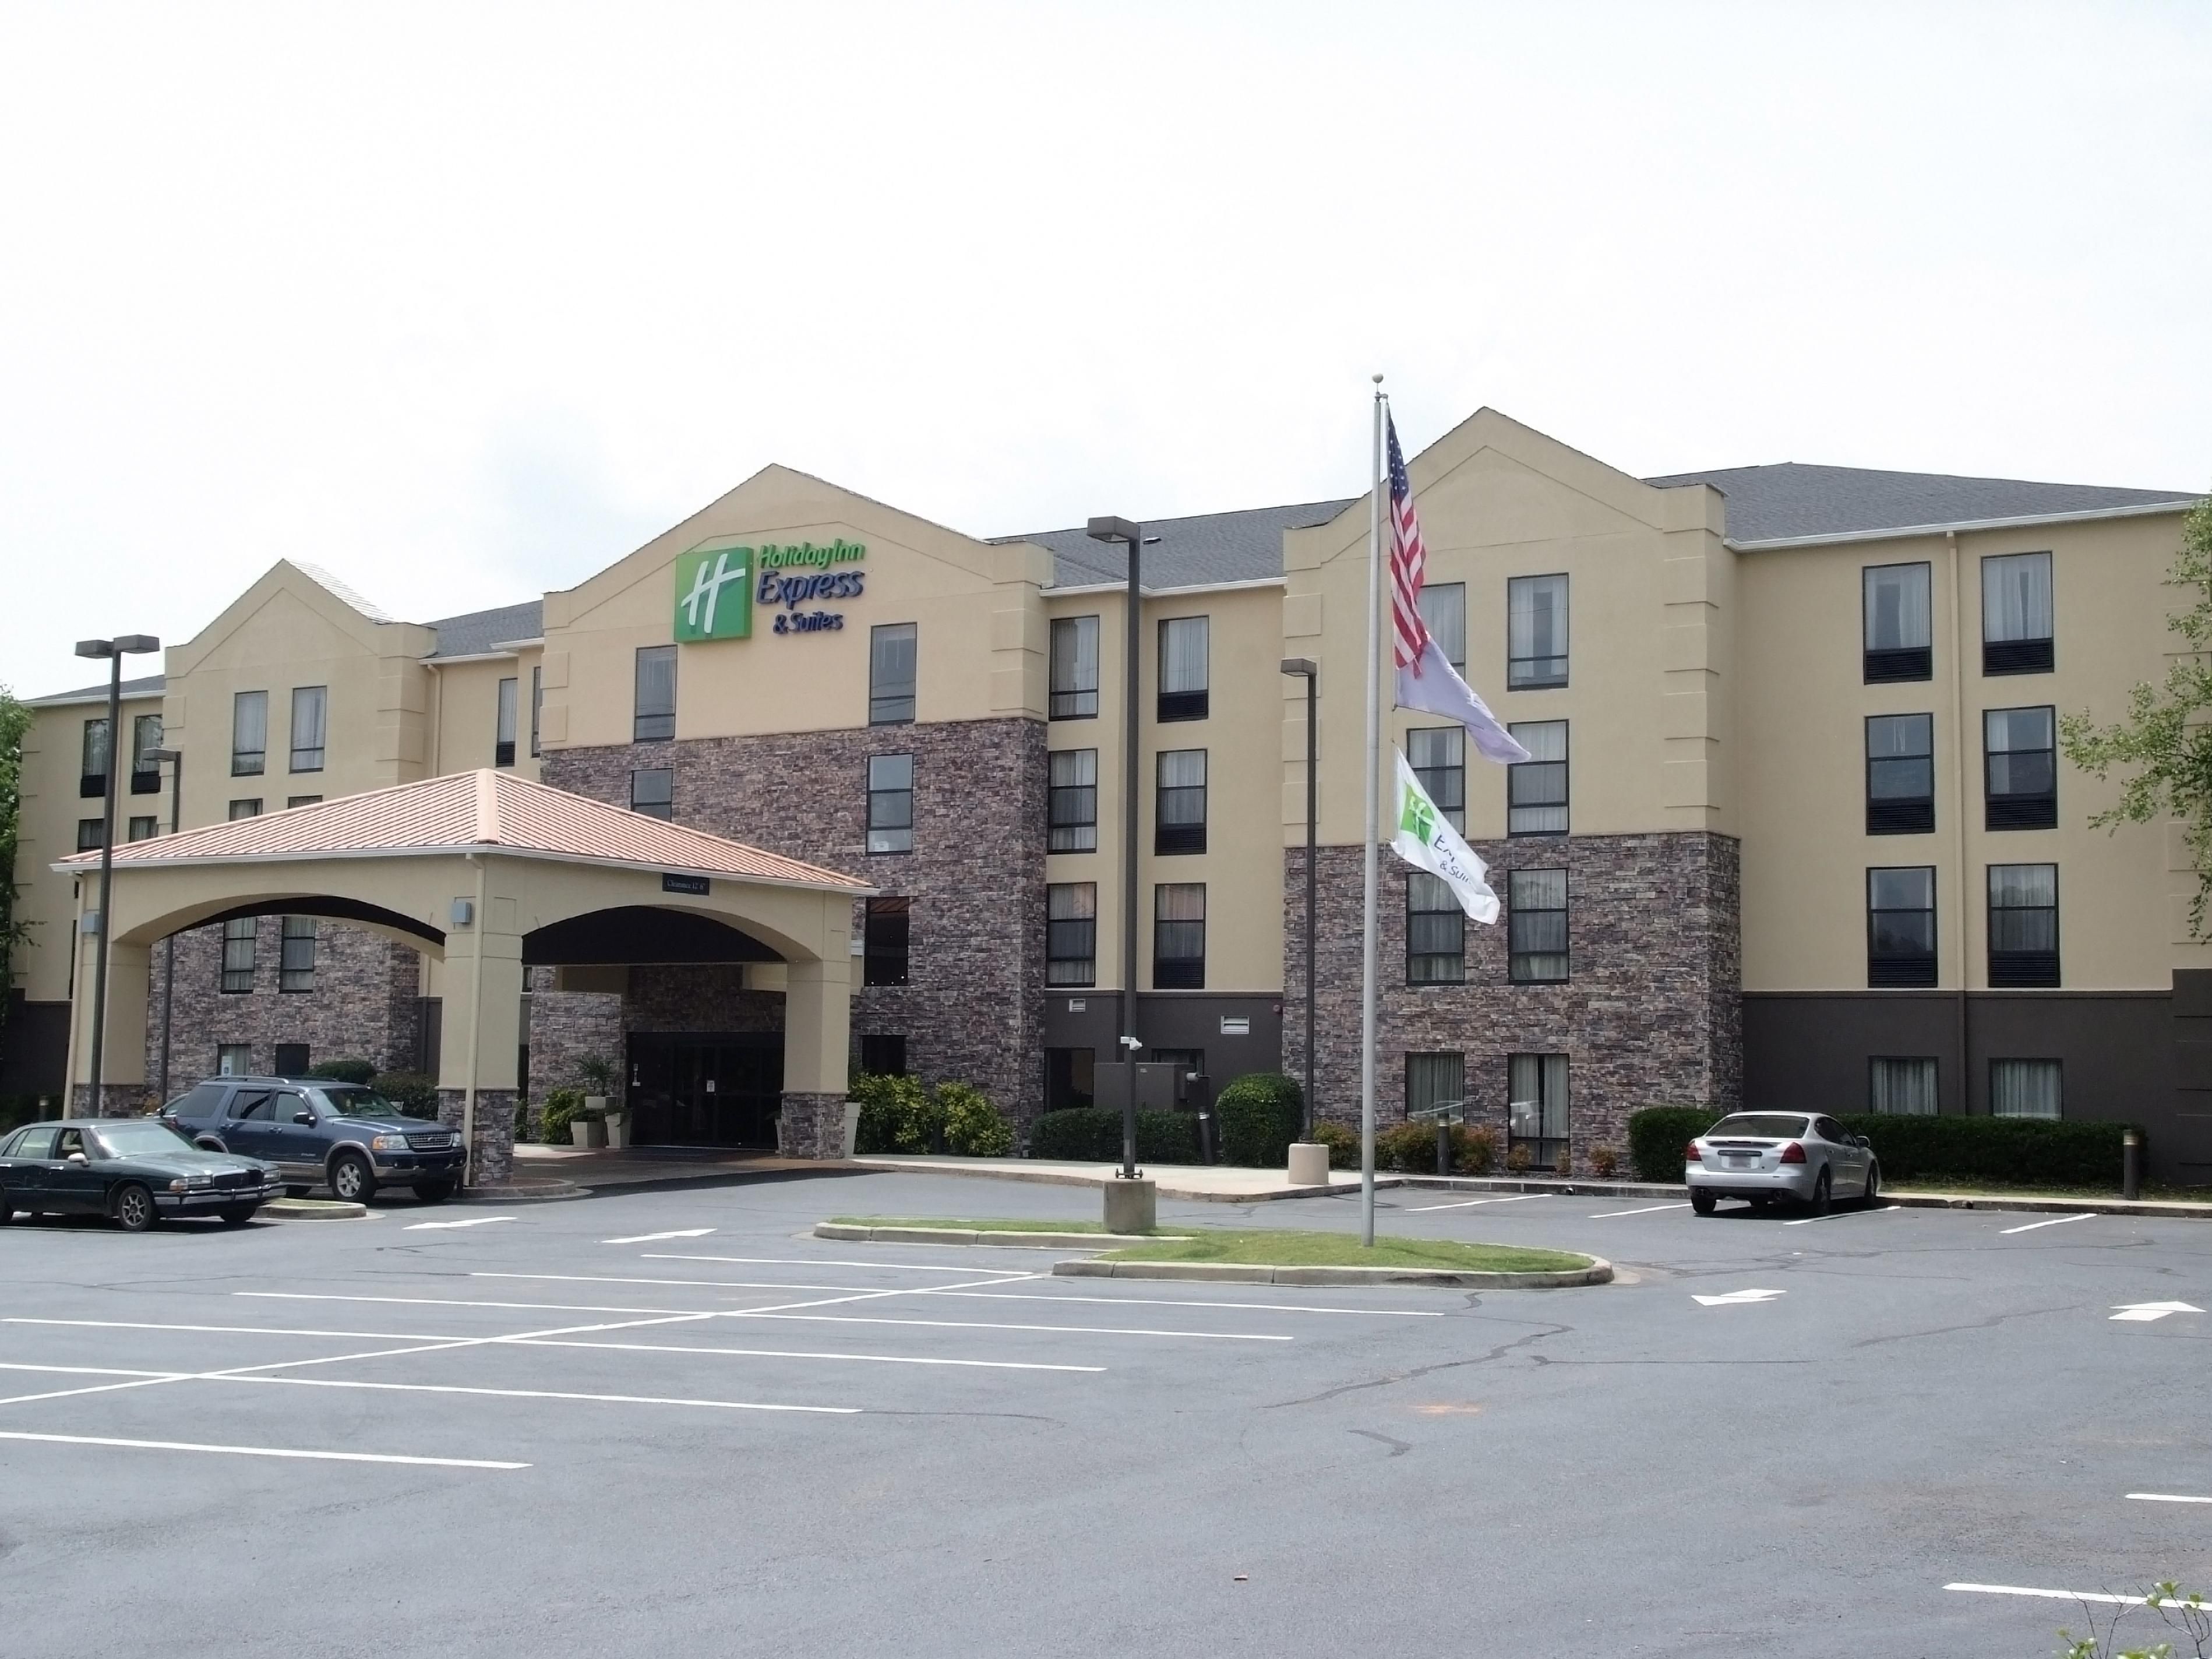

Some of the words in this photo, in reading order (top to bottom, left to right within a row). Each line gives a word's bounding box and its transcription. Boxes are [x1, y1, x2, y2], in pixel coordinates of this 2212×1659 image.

[758, 542, 832, 569] Holiday
[833, 538, 866, 562] Inn
[756, 571, 865, 610] Express
[773, 614, 789, 634] &
[789, 611, 844, 633] Suites
